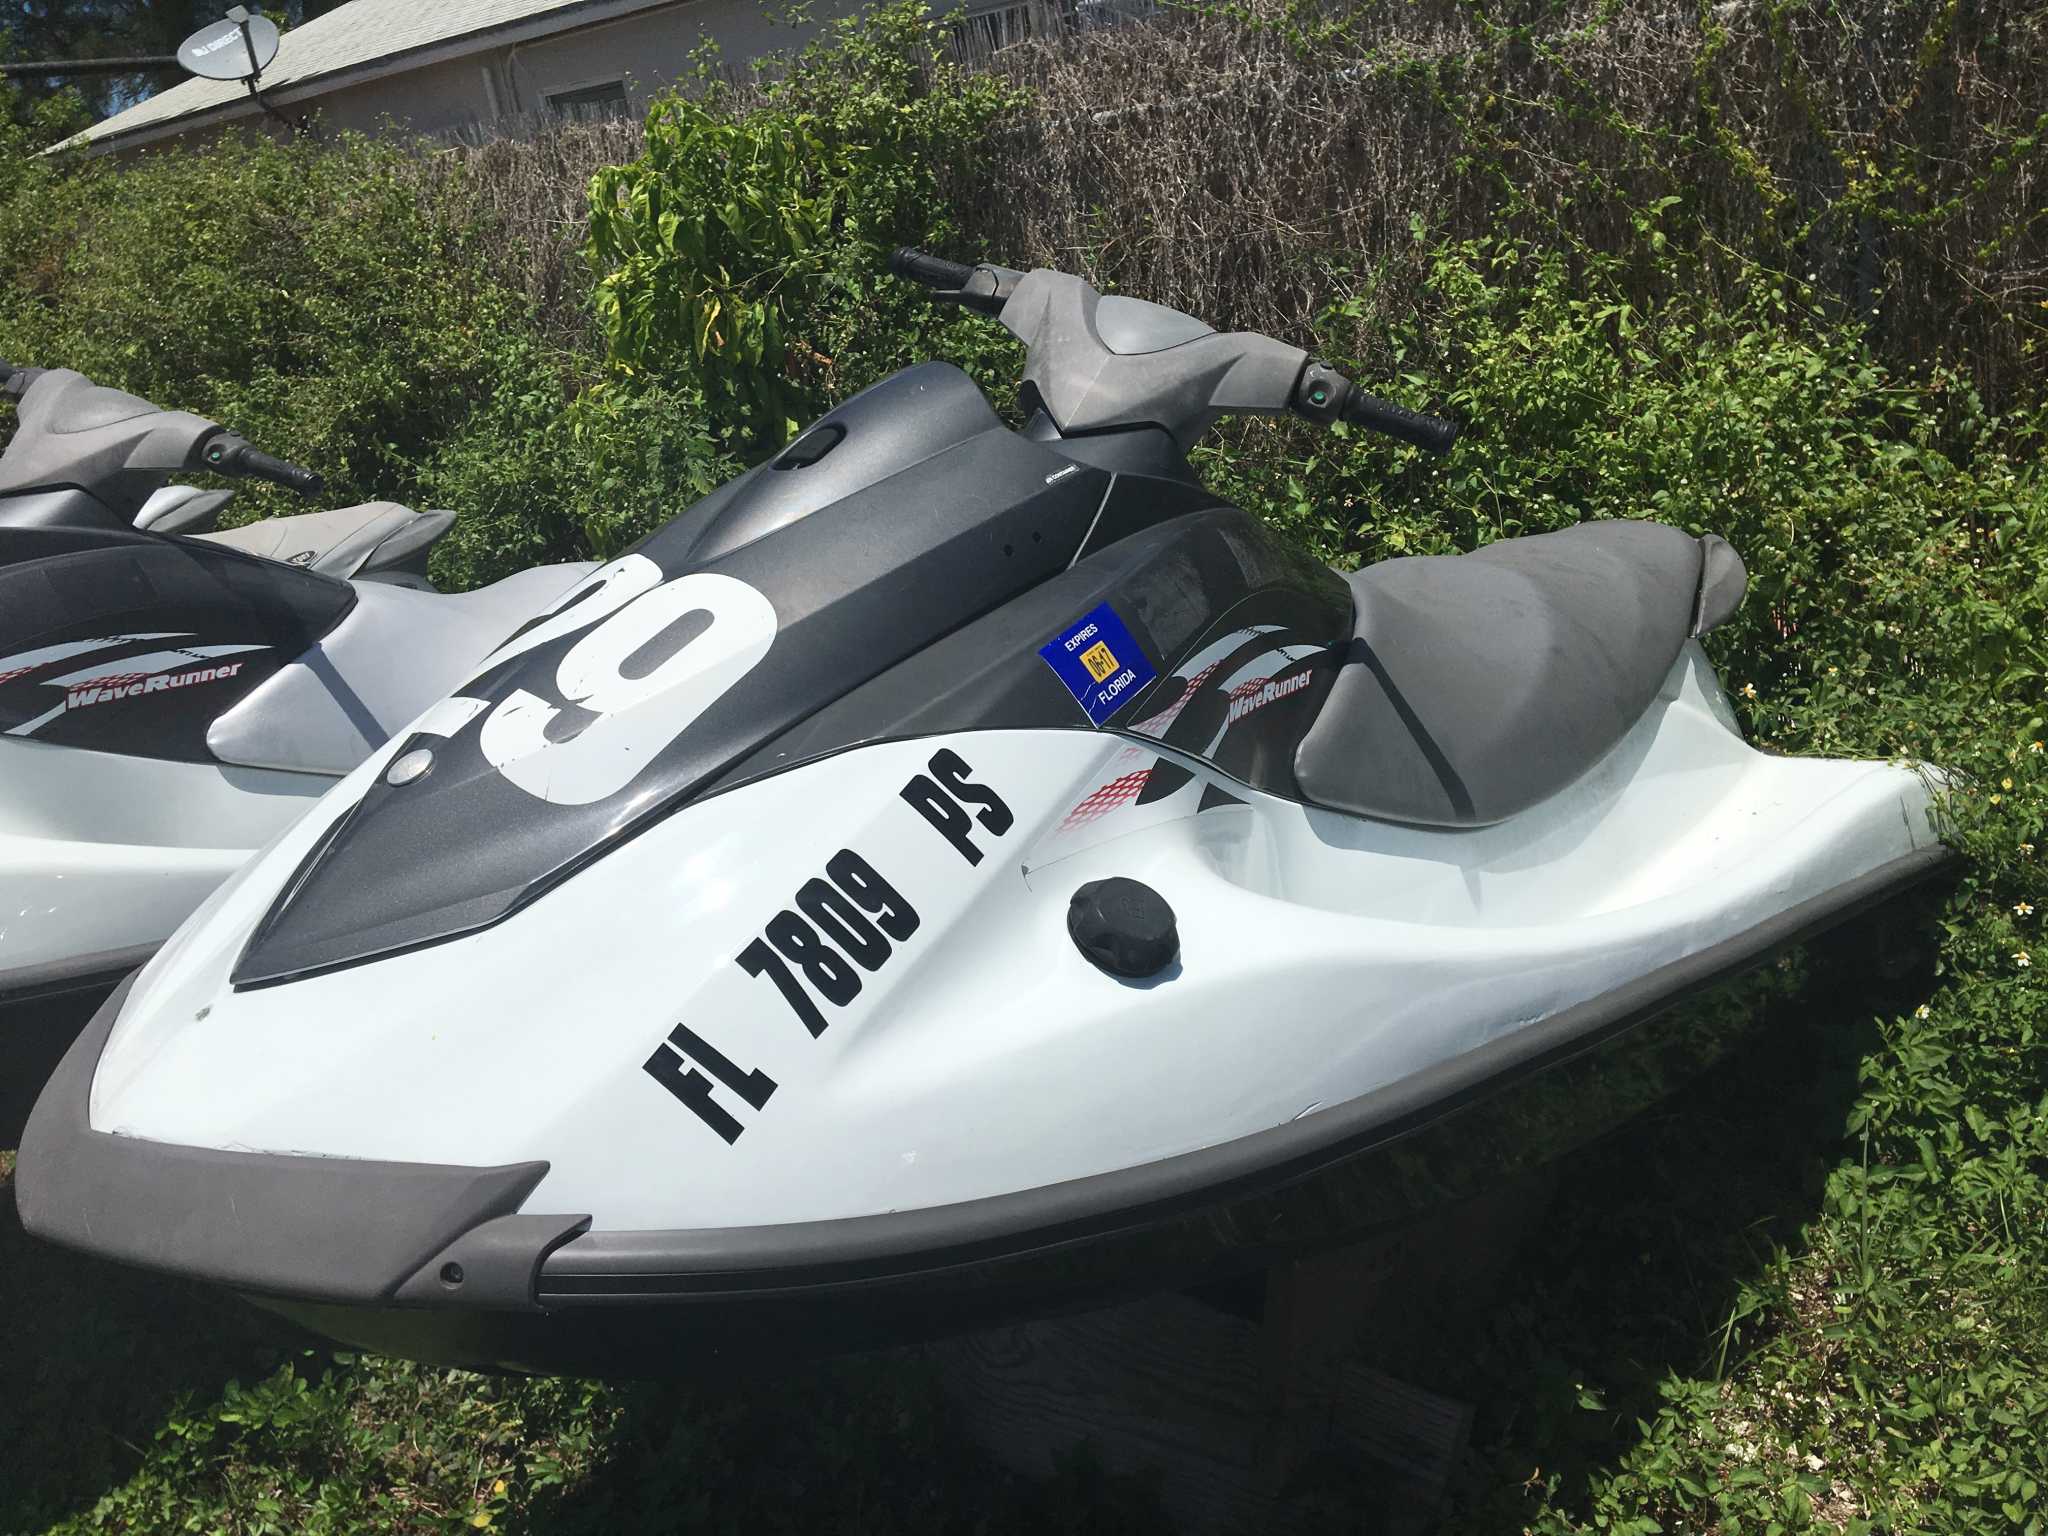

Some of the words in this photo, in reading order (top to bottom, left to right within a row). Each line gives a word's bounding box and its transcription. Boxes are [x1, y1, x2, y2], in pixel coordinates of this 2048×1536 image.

[1064, 623, 1098, 652] EXPIRES
[1088, 647, 1115, 677] 06-17
[68, 662, 243, 710] WaveRunner
[1098, 669, 1136, 705] FLORIDA
[1229, 669, 1313, 724] WaveRunner
[643, 1022, 778, 1146] FL
[735, 849, 920, 1039] 7809
[899, 748, 1014, 867] PS
